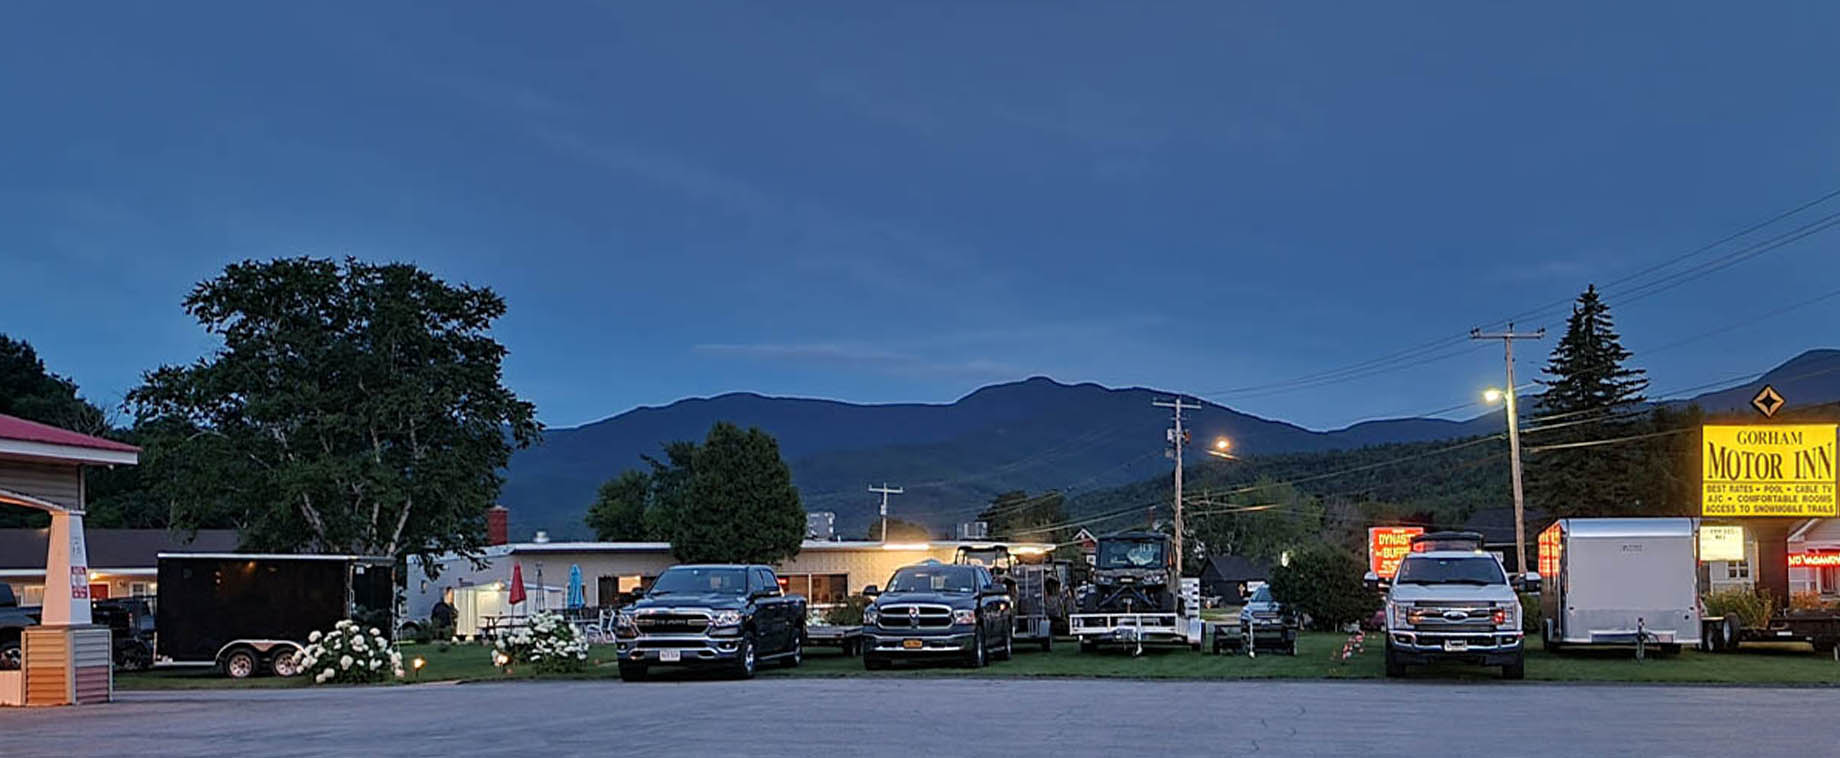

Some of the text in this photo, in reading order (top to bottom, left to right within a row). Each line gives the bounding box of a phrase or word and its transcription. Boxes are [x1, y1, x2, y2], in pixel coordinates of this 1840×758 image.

[1737, 431, 1803, 445] GORHAM
[1708, 441, 1832, 481] MOTOR INN
[1706, 485, 1832, 493] BEST RATES POOL CABLE TV
[1737, 495, 1798, 503] COMFORTABLE
[1802, 495, 1833, 503] ROOMS
[1706, 504, 1834, 513] ACCESS TO SNOWMOBILE TRAILS
[1378, 533, 1416, 545] DYNAST
[1383, 545, 1411, 558] BUFF
[1788, 555, 1800, 565] NO
